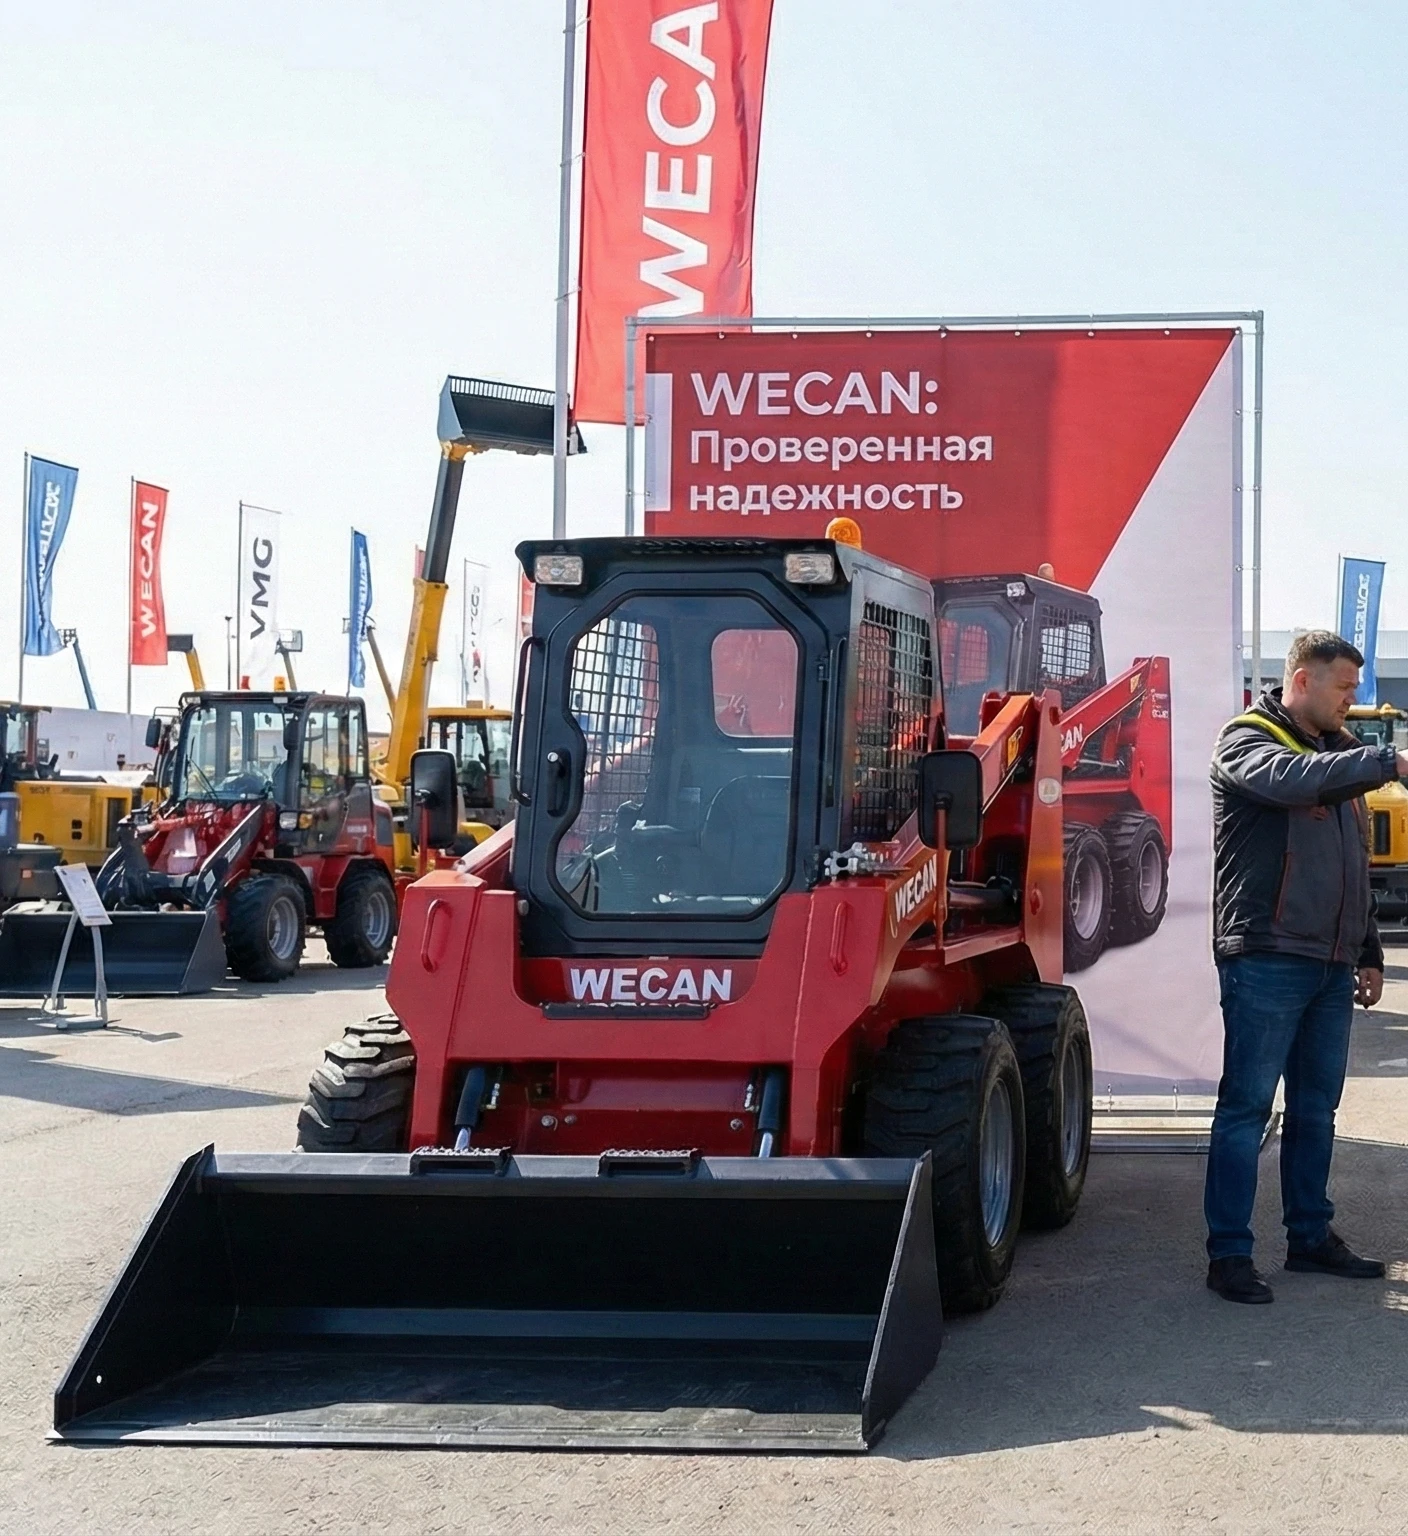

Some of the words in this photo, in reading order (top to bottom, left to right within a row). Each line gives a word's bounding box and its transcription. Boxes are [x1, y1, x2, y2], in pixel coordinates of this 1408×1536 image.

[691, 371, 938, 416] WECAN:
[691, 430, 993, 472] Проверенная
[690, 483, 963, 516] надежность
[139, 501, 163, 638] WECAN
[250, 537, 273, 640] VMG
[894, 853, 938, 923] WECAN
[570, 967, 732, 1001] WECAN
